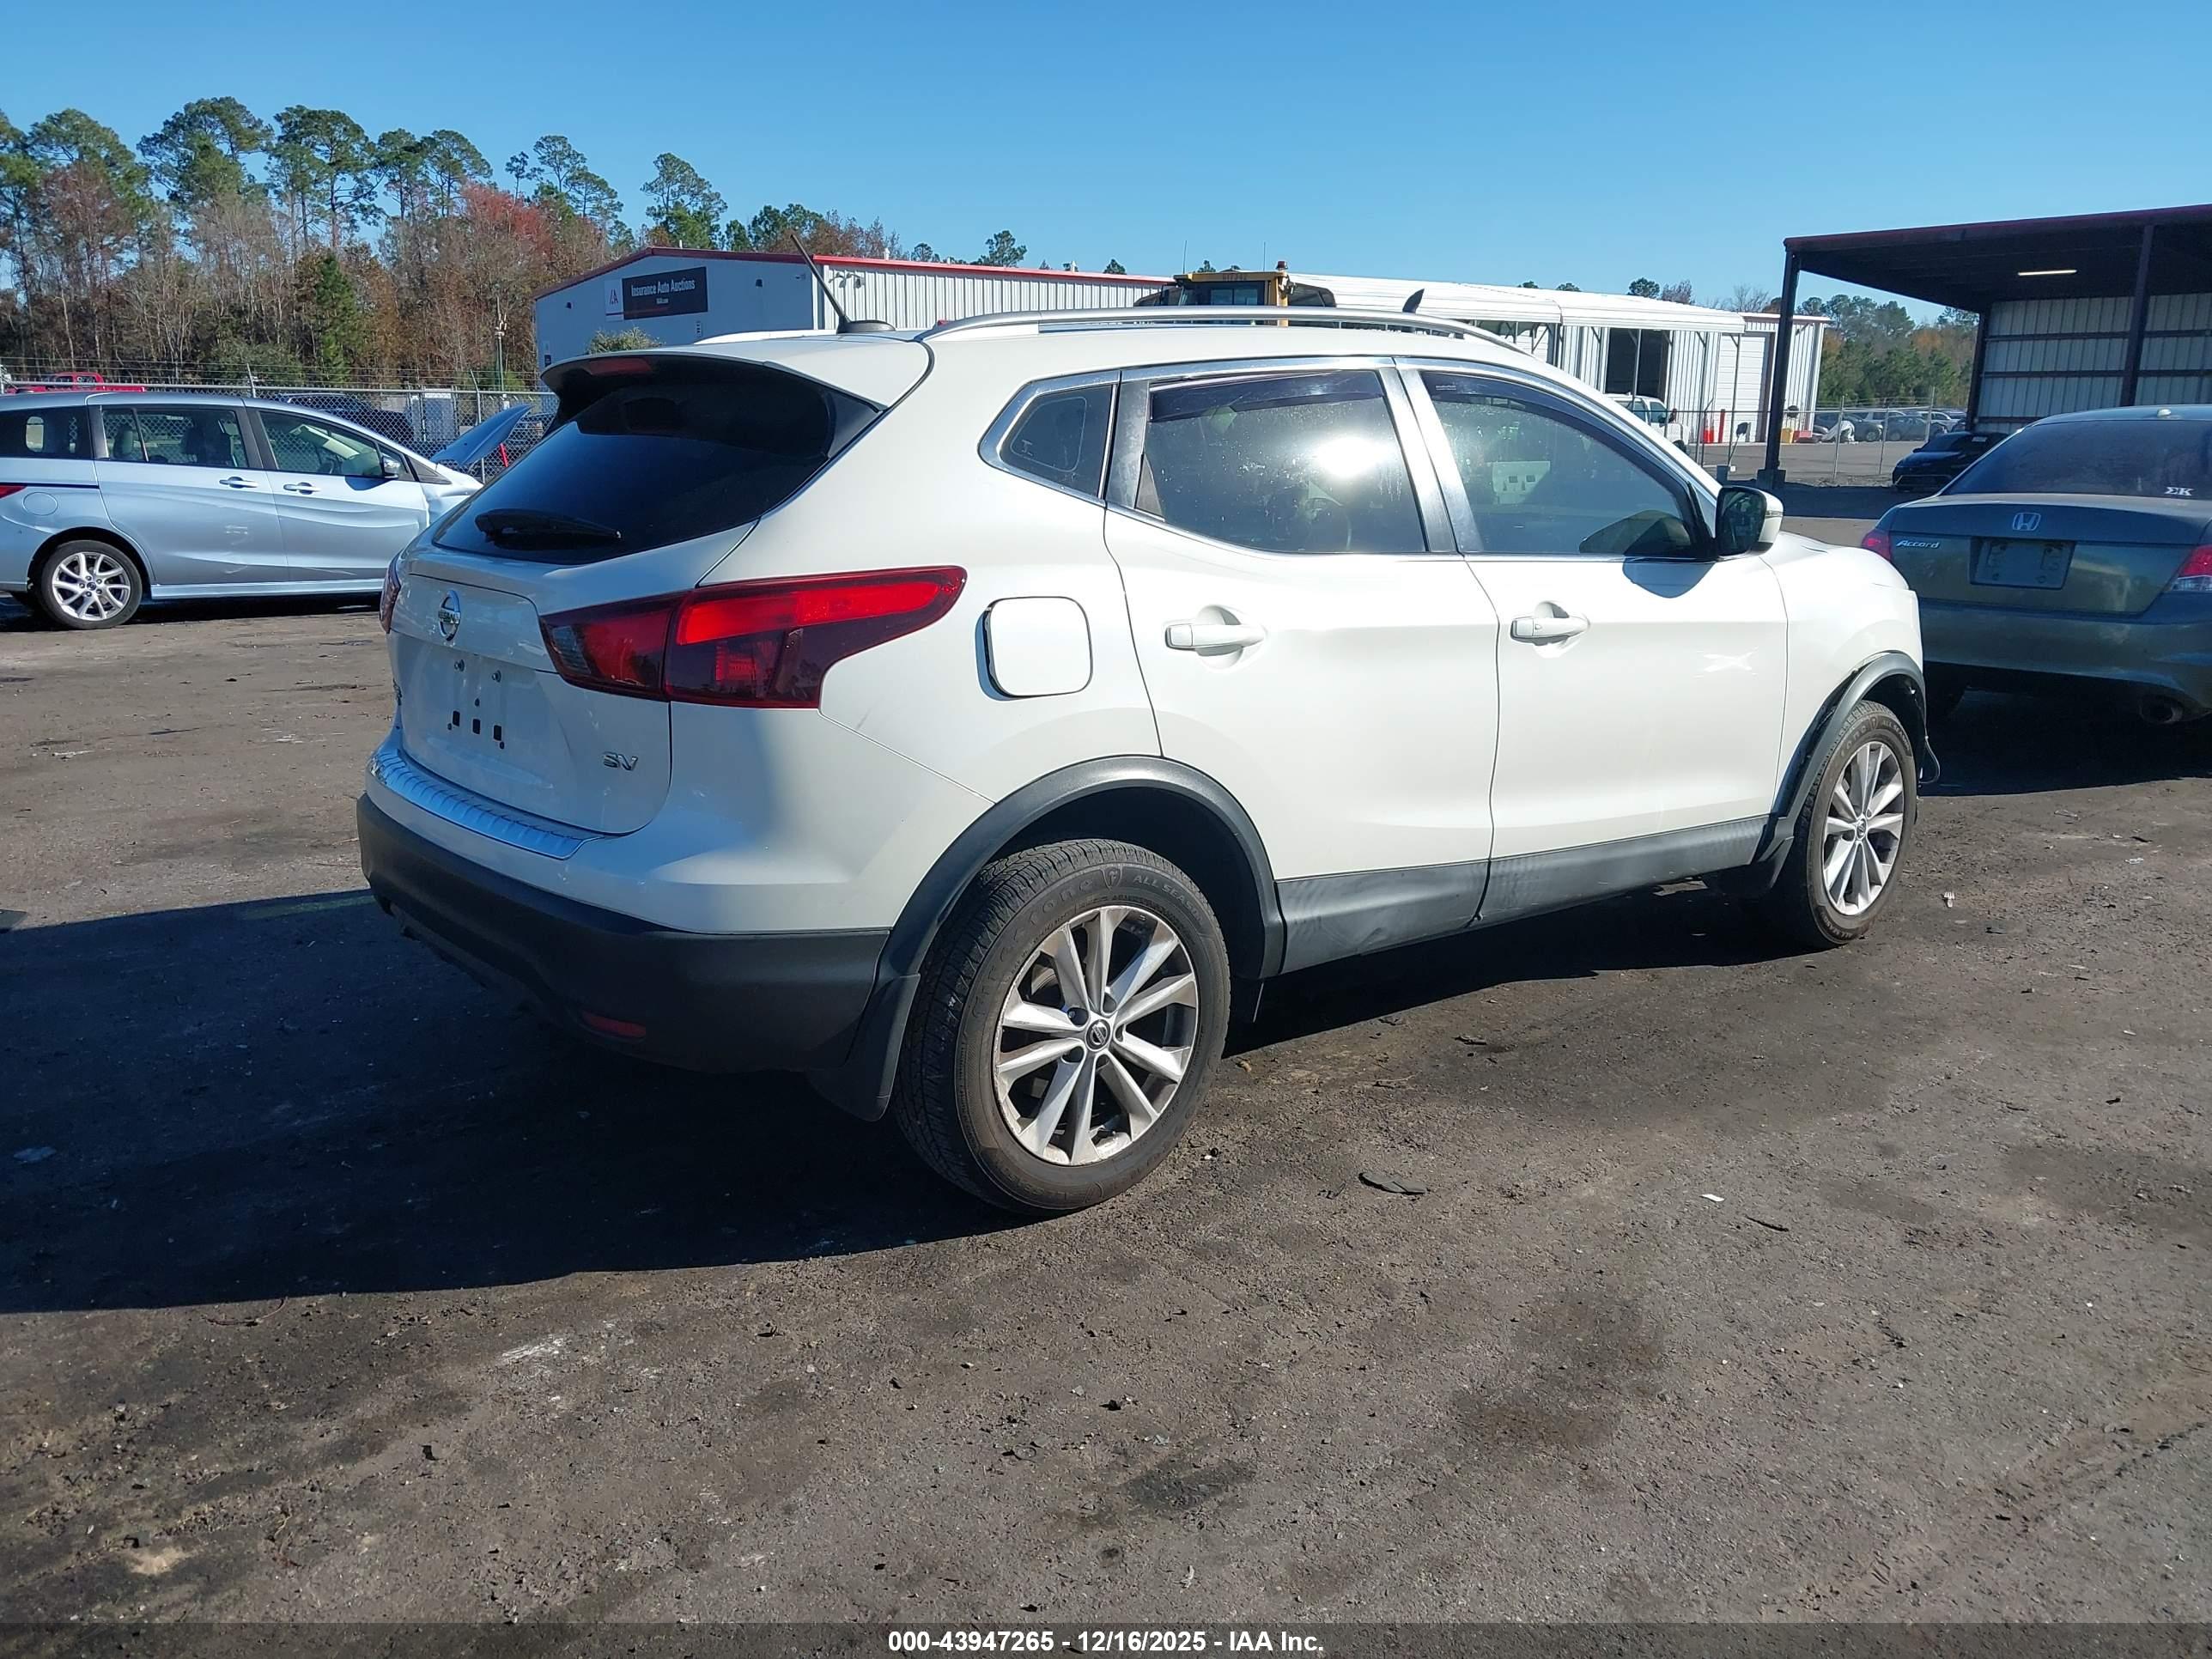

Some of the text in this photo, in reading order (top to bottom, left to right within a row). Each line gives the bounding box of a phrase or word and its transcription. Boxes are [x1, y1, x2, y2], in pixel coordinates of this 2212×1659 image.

[631, 278, 696, 296] Insurance Auto Auctions
[1896, 539, 1940, 549] Accord
[603, 751, 639, 771] SV
[1133, 875, 1159, 888] ALL
